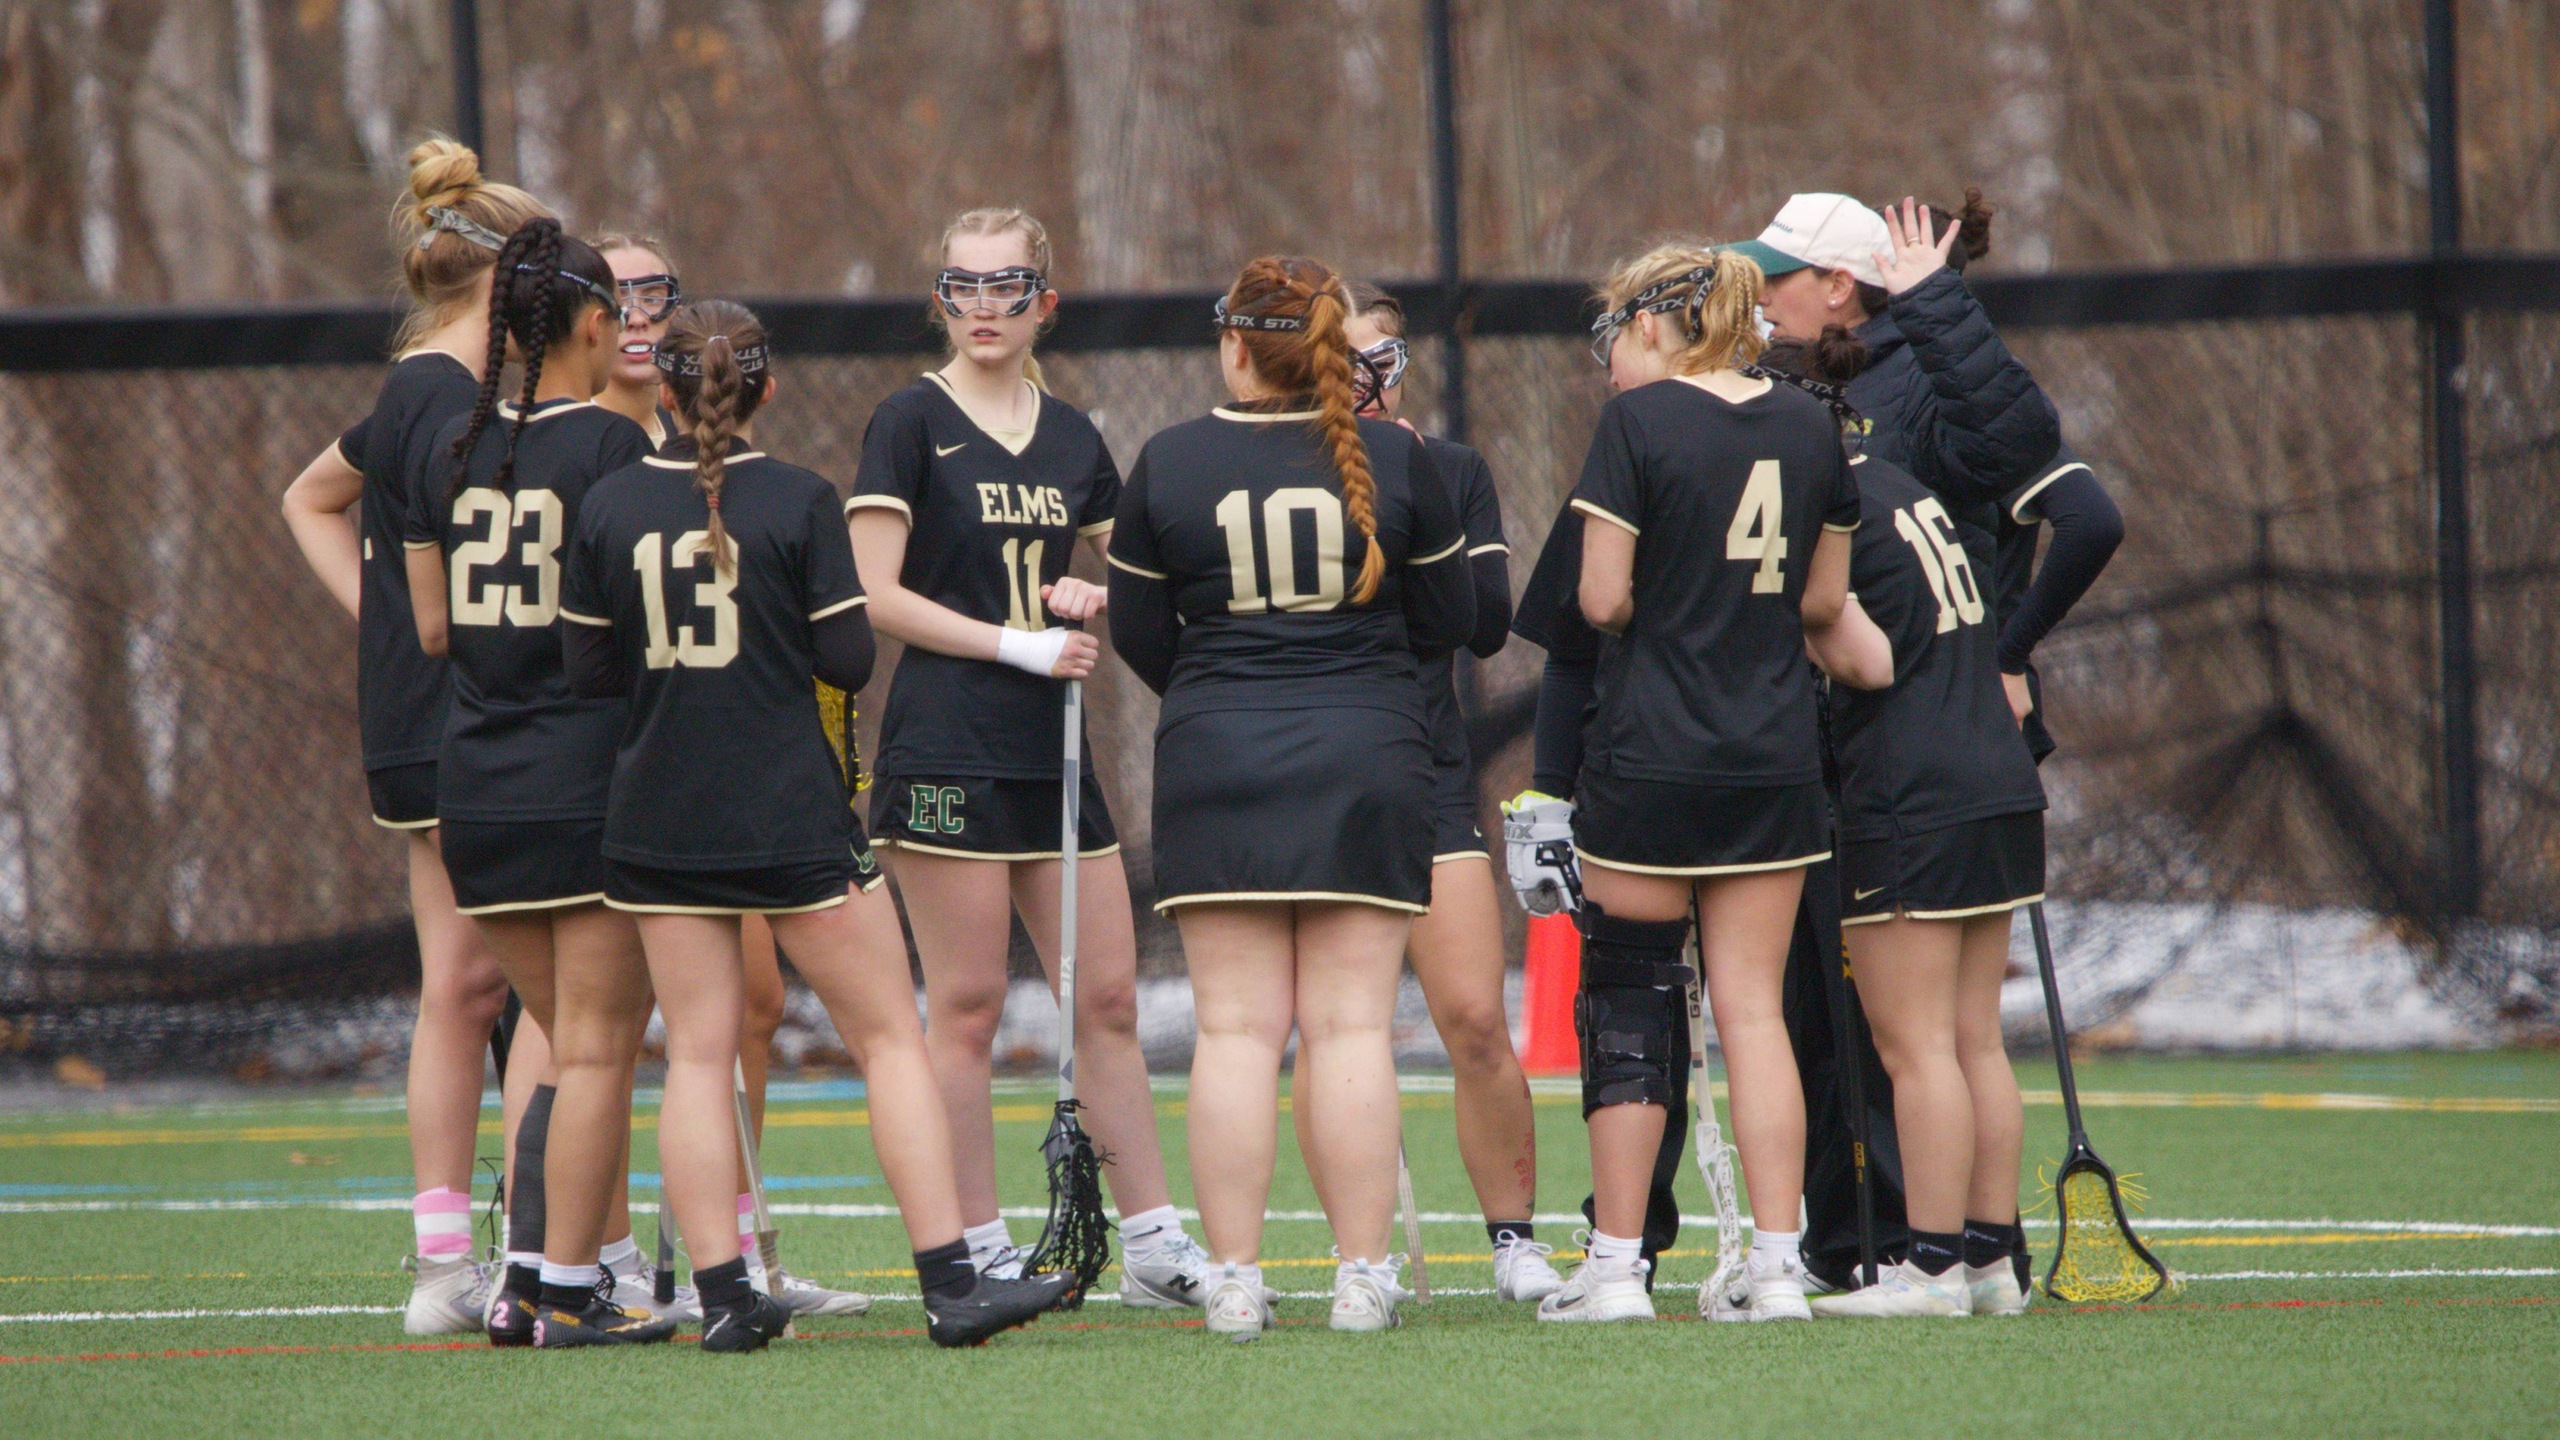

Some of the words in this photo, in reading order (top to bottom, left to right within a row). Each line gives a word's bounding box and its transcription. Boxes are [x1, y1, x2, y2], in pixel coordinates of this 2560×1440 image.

[1692, 277, 1713, 308] STX
[1230, 314, 1255, 328] STX
[1264, 317, 1301, 330] STX
[1801, 378, 1834, 395] STX
[976, 482, 1068, 527] ELMS
[1726, 459, 1788, 594] 4
[451, 487, 563, 627] 23
[1216, 487, 1344, 613] 10
[1895, 496, 1985, 635] 16
[633, 529, 739, 669] 13
[1002, 538, 1047, 632] 11
[908, 784, 965, 834] EC
[490, 1300, 510, 1329] 2
[532, 1318, 545, 1348] 3
